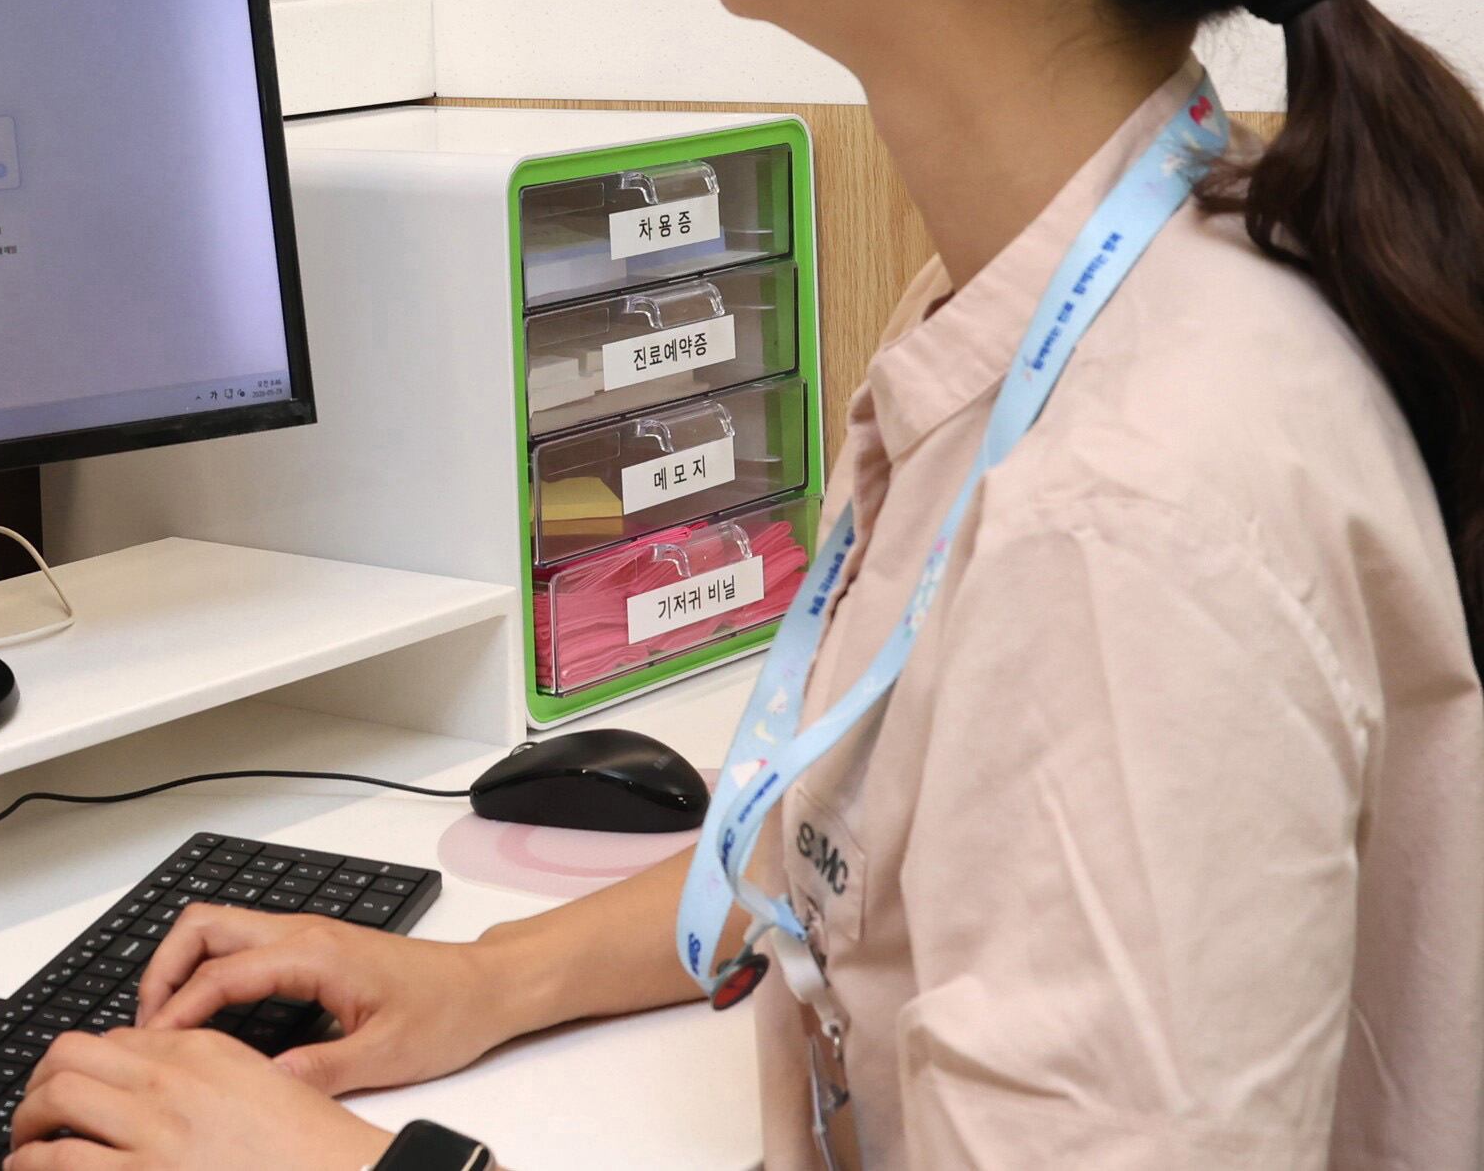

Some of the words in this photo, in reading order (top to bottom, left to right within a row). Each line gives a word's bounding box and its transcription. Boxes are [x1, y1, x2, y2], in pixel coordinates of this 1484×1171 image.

[633, 330, 709, 371] 진료예약증
[657, 586, 702, 620] 기저귀
[708, 574, 736, 603] 비닐
